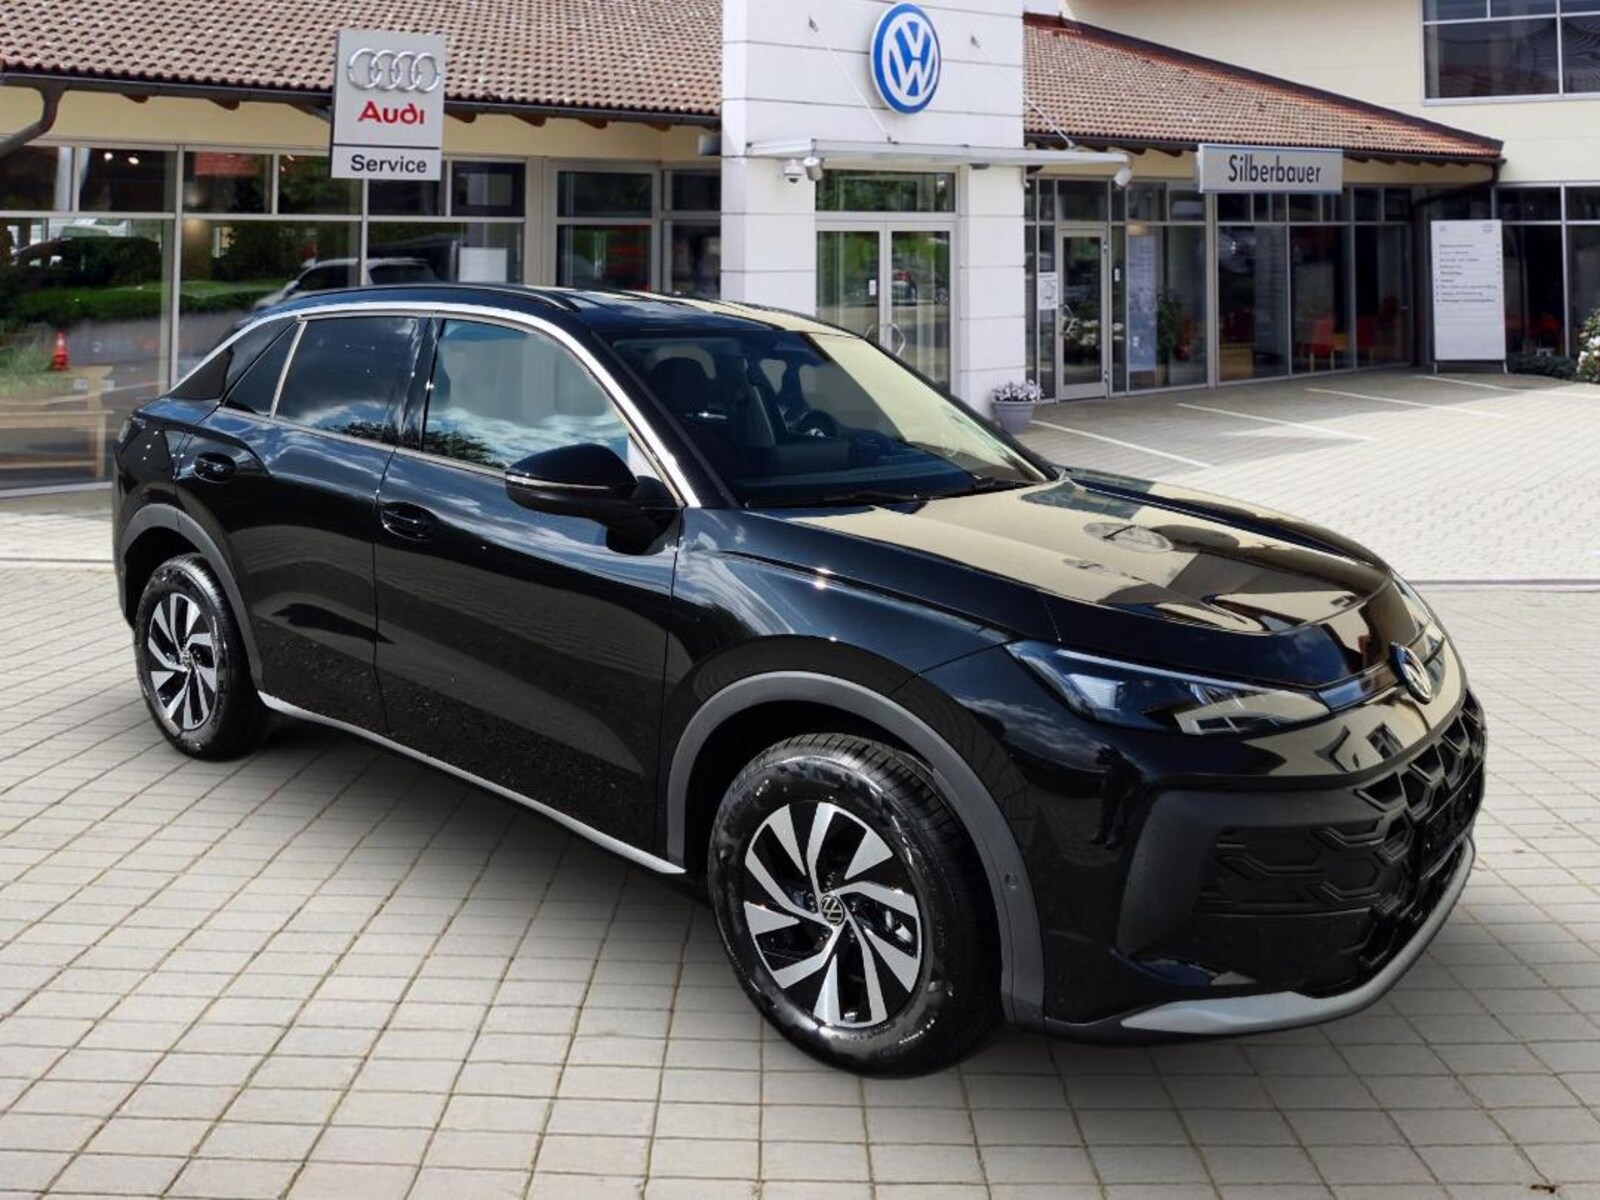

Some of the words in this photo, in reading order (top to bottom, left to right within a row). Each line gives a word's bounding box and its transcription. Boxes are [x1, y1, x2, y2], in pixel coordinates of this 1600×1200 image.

[358, 101, 424, 125] Audi
[351, 154, 427, 173] Service
[1228, 154, 1321, 183] Silberbauer
